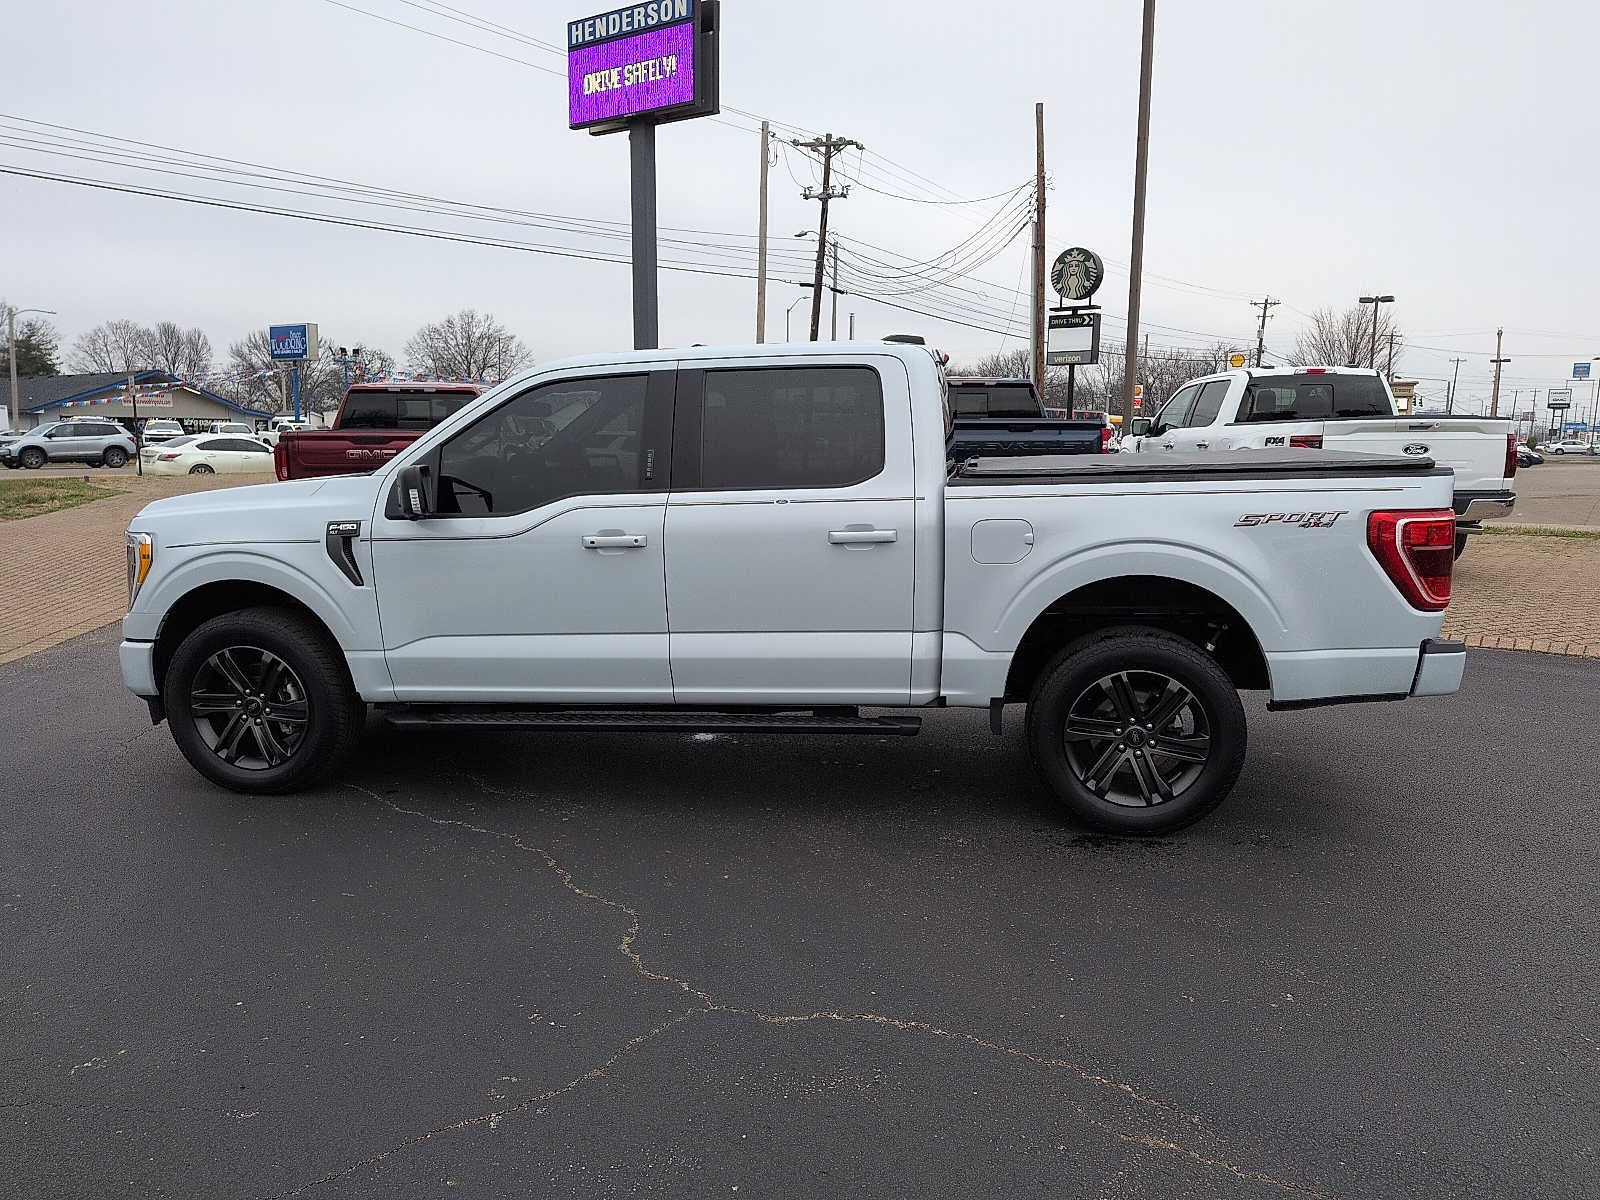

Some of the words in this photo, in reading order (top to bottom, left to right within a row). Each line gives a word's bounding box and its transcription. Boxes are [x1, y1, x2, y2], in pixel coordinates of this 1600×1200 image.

[571, 0, 688, 45] HENDERSON
[583, 67, 623, 95] DRIVE
[1054, 355, 1081, 363] verizon
[1265, 437, 1285, 447] FX4
[346, 449, 397, 460] GMC
[1233, 510, 1350, 528] SPORT
[329, 523, 357, 531] F-150
